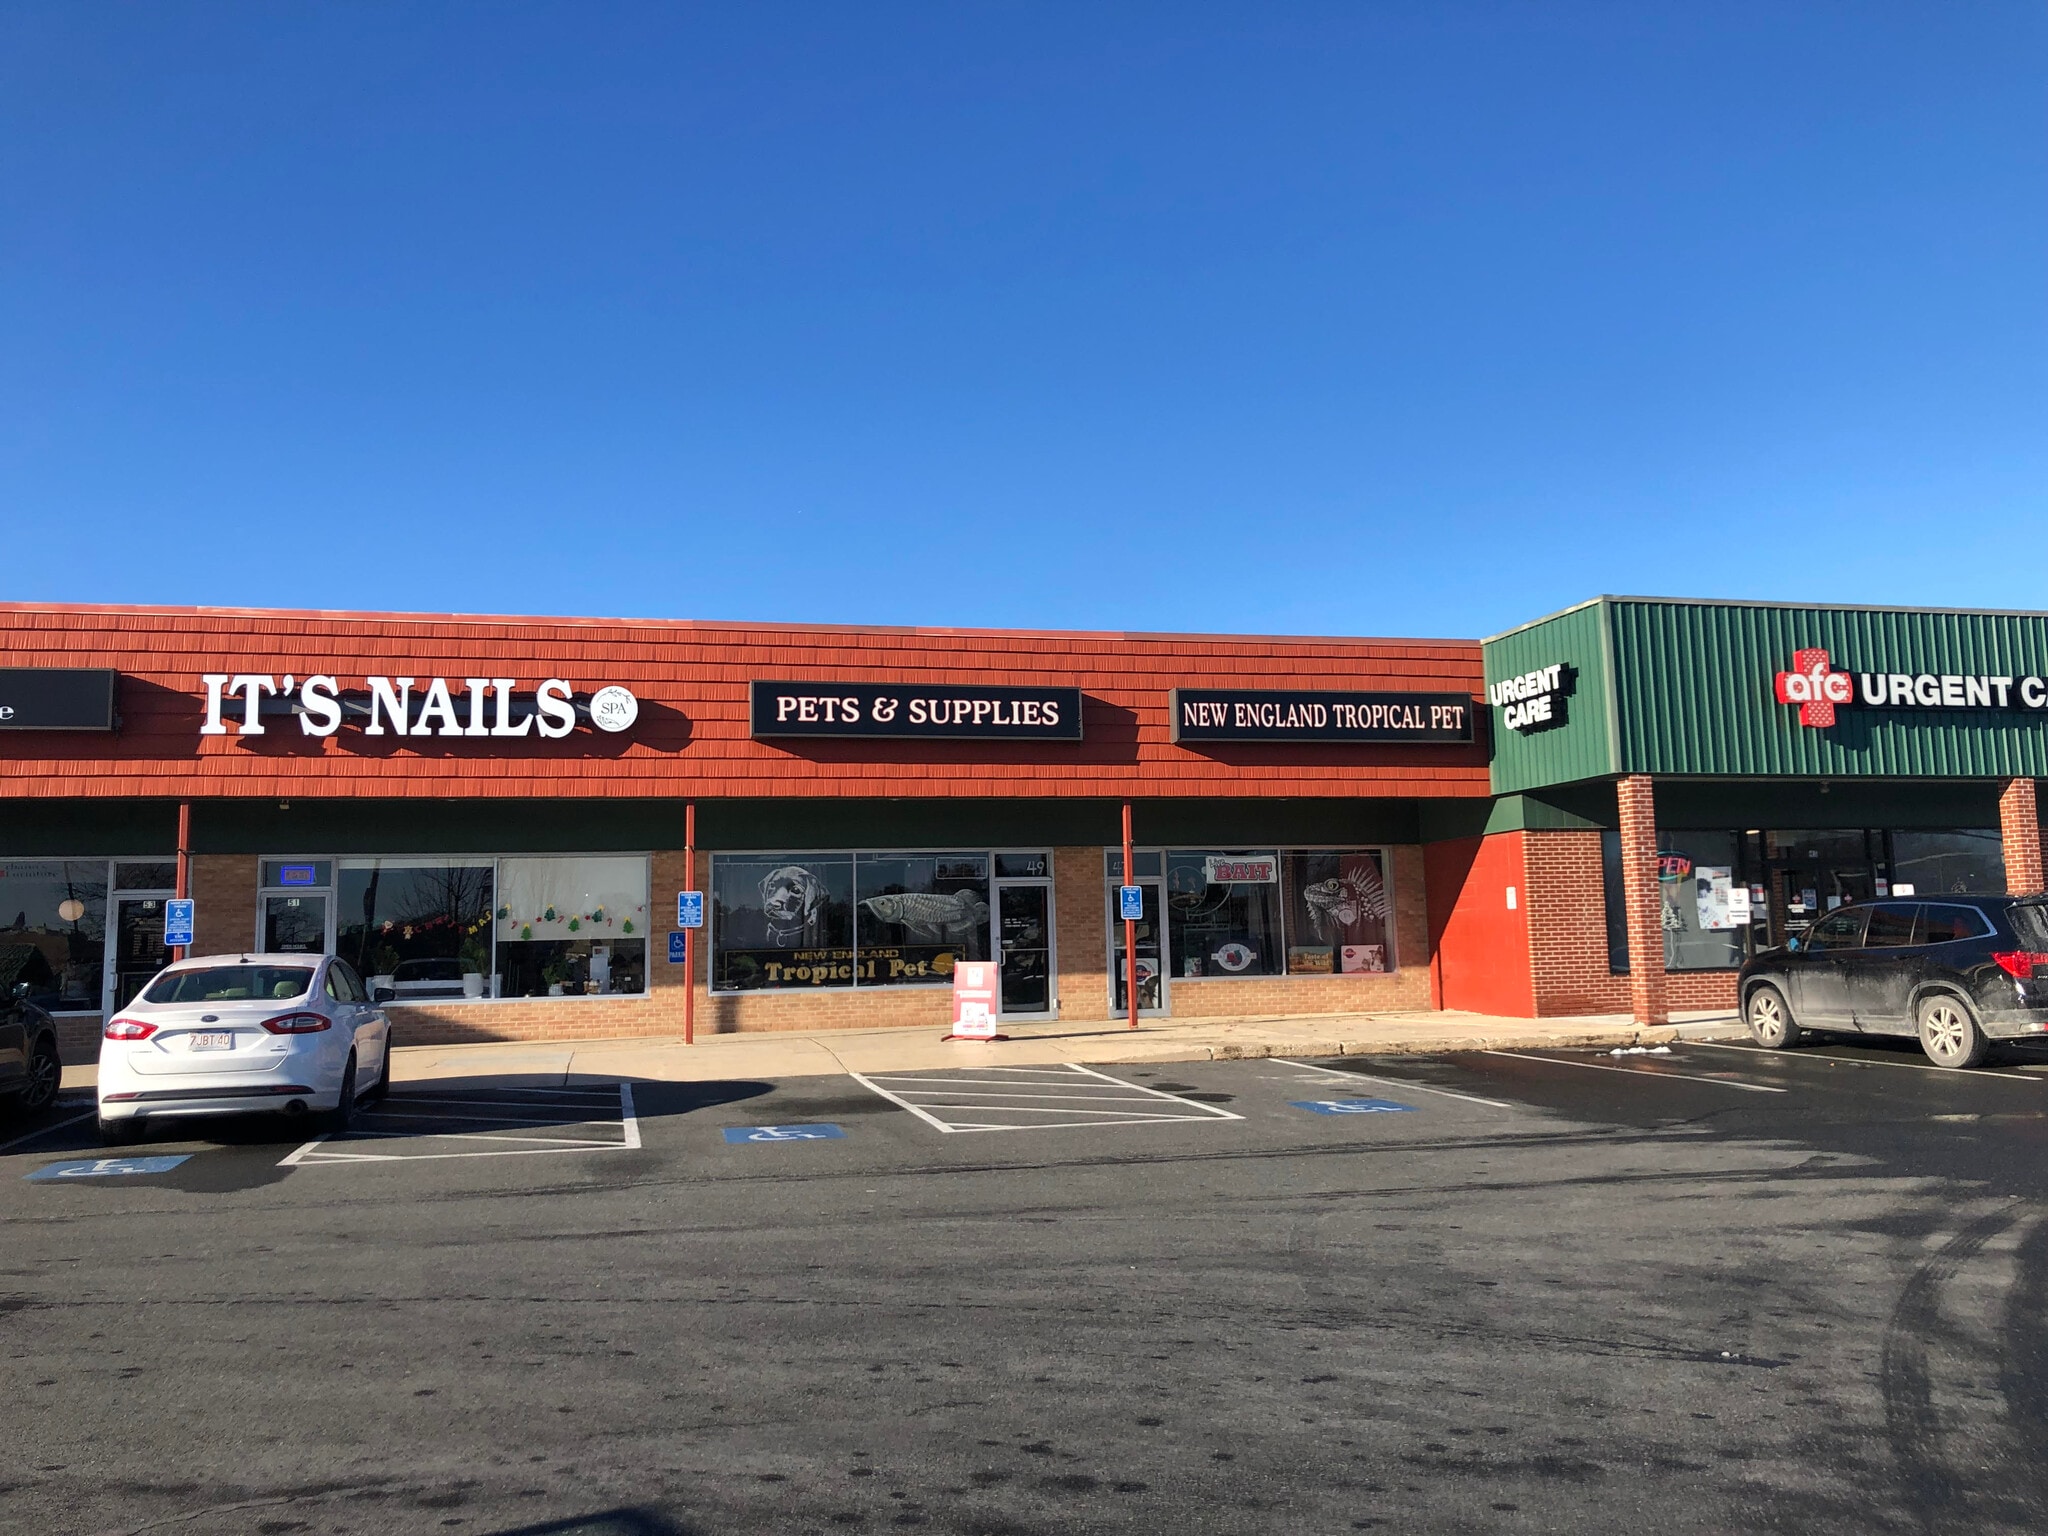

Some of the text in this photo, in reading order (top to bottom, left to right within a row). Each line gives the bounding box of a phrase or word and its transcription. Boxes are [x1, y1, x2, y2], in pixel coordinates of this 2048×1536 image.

[1489, 663, 1561, 707] URGENT
[1786, 661, 2048, 708] afc URGENT C
[200, 674, 576, 738] IT'S NAILS
[600, 702, 627, 715] SPA
[776, 696, 1060, 726] PETS & SUPPLIES
[1503, 694, 1553, 730] CARE
[1183, 702, 1464, 730] NEW ENGLAND TROPICAL PET
[1026, 860, 1045, 876] 49
[1113, 861, 1125, 875] 4
[1214, 862, 1273, 882] BAIT
[1657, 857, 1691, 875] PEN
[143, 900, 156, 909] 53
[288, 899, 300, 907] 51
[793, 951, 827, 961] NEW
[764, 958, 928, 985] Tropical Pet
[217, 1034, 230, 1045] 40
